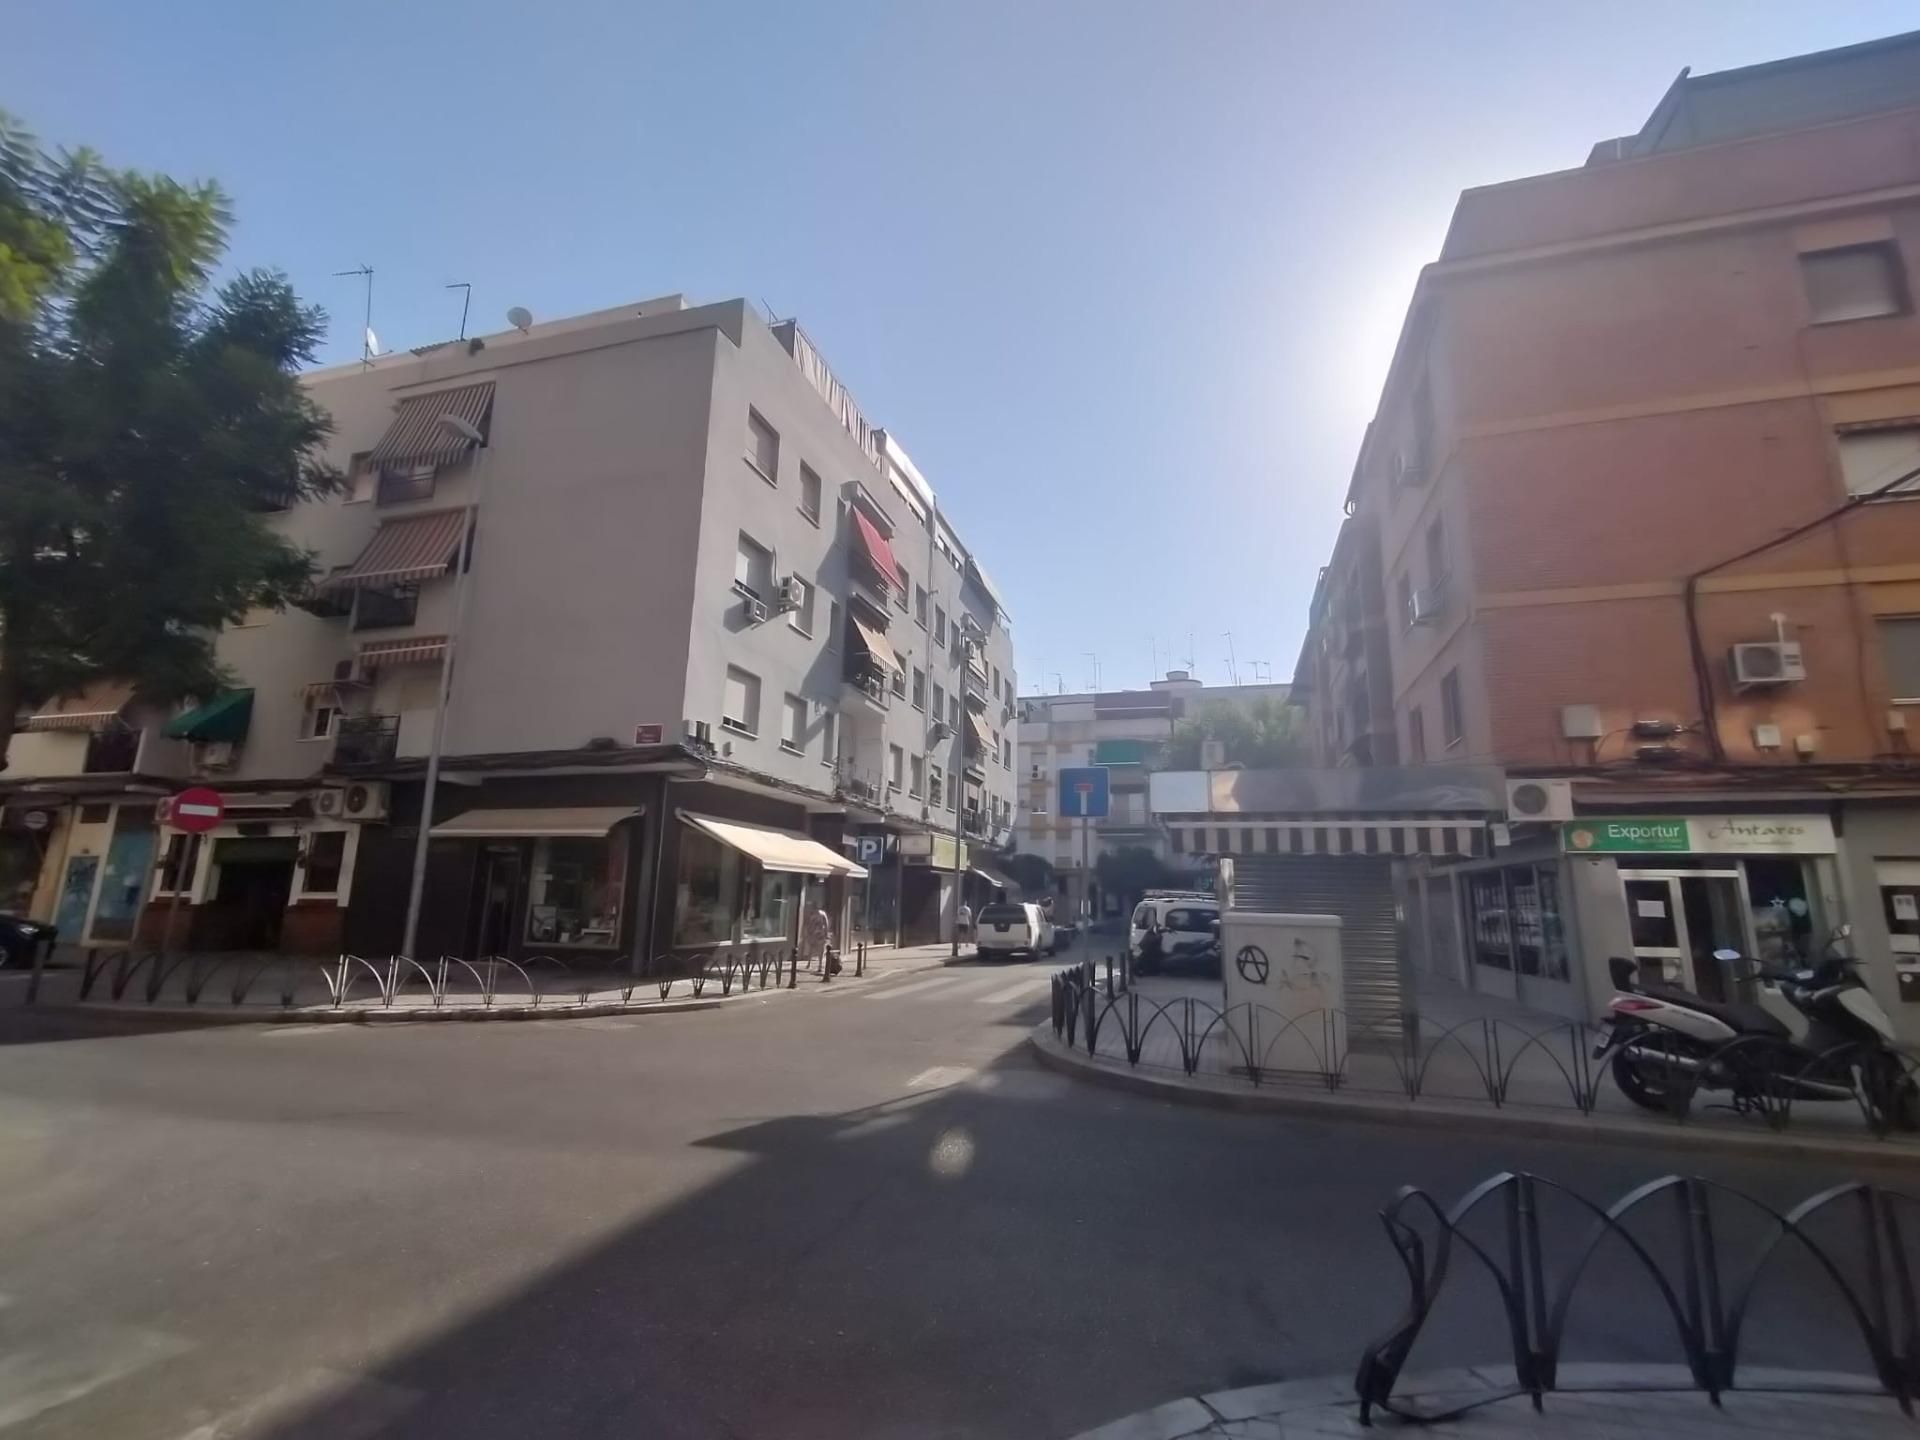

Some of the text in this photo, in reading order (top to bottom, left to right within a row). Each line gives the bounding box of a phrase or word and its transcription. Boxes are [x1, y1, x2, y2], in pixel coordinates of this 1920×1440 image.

[1607, 824, 1680, 840] Exportur
[1707, 817, 1805, 840] Antares
[861, 840, 878, 861] P
